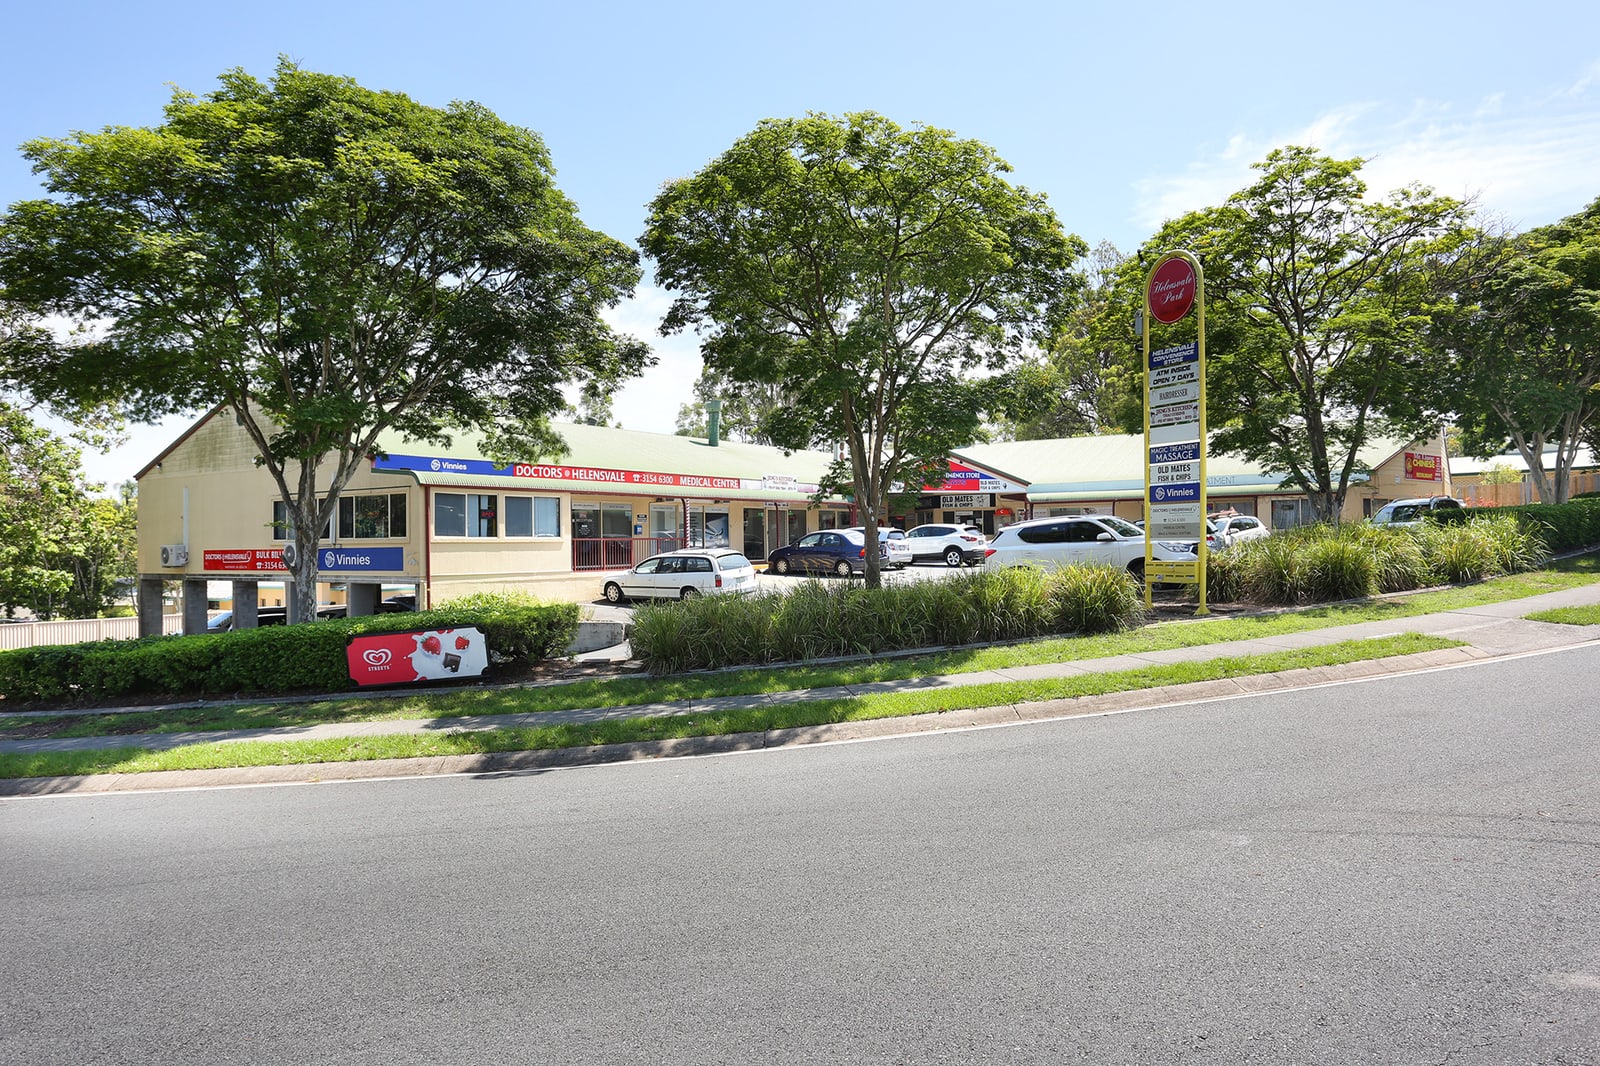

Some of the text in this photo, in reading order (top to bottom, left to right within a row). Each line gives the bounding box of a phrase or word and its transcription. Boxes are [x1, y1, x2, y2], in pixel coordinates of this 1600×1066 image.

[1154, 272, 1192, 294] Helensvale
[1163, 288, 1184, 304] Park
[1152, 342, 1196, 357] HELENSVALE
[1153, 349, 1195, 362] CONVENIENCE
[1163, 356, 1184, 366] STORE
[1156, 364, 1191, 377] ATM INSIDE
[1153, 376, 1171, 385] OPEN
[1177, 372, 1195, 381] DAYS
[1150, 443, 1199, 454] MAGIC TREATMENT
[1155, 450, 1193, 463] MASSAGE
[441, 462, 468, 471] Vinnies
[1157, 463, 1191, 474] OLD MATES
[1413, 459, 1436, 468] CHINESE
[516, 465, 563, 479] DOCTORS
[572, 469, 625, 482] HELENSVALE
[658, 475, 674, 485] 6300
[680, 476, 712, 487] MEDICAL
[713, 479, 739, 488] CENTRE
[1176, 473, 1192, 481] CHIPS
[1166, 487, 1195, 497] Vinnies
[942, 495, 974, 504] OLD MATES
[256, 551, 270, 559] BULK
[336, 553, 371, 566] Vinnies
